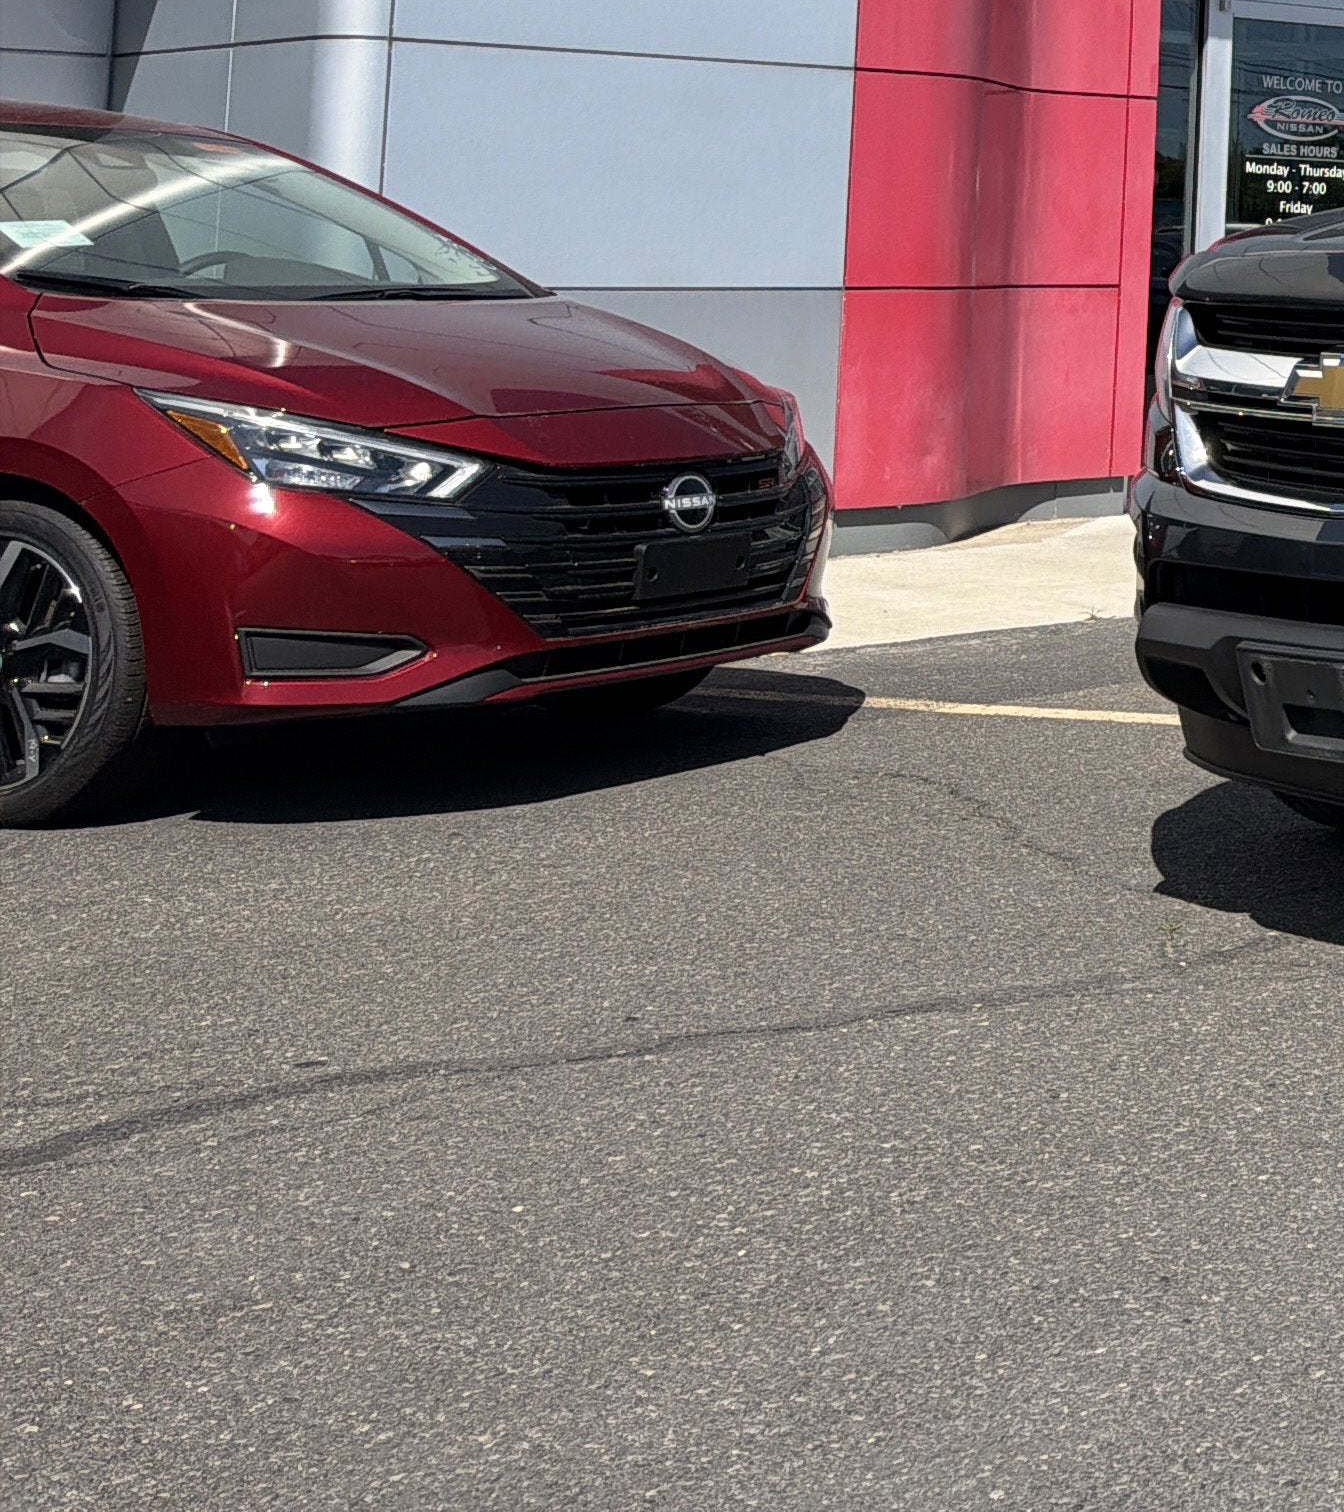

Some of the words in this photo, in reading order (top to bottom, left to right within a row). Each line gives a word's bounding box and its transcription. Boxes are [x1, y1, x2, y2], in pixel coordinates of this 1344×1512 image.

[1262, 75, 1323, 92] WELCOME
[1325, 80, 1343, 94] TO
[1267, 98, 1337, 122] Romeo
[1276, 122, 1324, 134] NISSAN
[1262, 142, 1297, 155] SALES
[1299, 145, 1338, 158] HOURS
[1245, 161, 1290, 178] Monday
[1266, 179, 1292, 193] 9:00
[1302, 182, 1327, 195] 7:00
[1279, 200, 1313, 215] Friday
[664, 494, 717, 510] NISSAN
